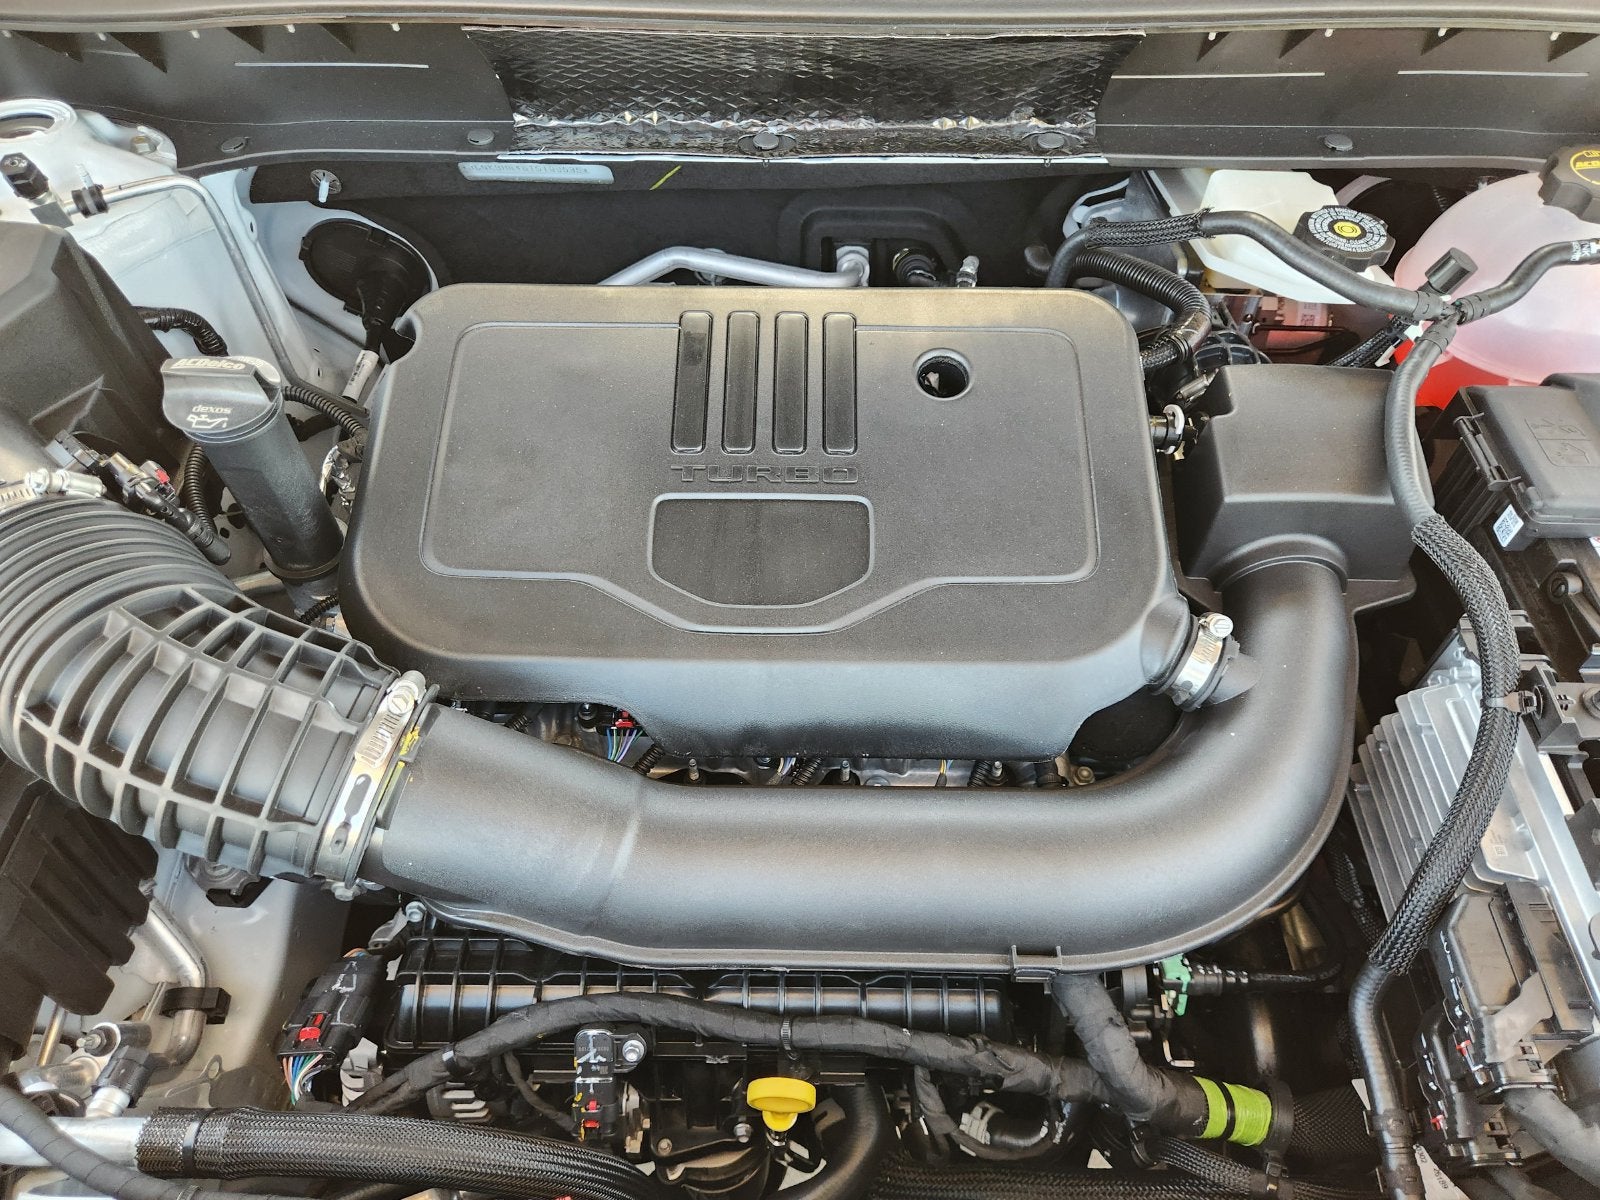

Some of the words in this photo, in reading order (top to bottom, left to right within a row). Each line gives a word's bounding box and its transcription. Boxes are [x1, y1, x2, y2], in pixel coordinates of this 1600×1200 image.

[170, 358, 247, 371] ACDelco
[191, 405, 234, 415] dexos
[670, 464, 859, 483] TURBO
